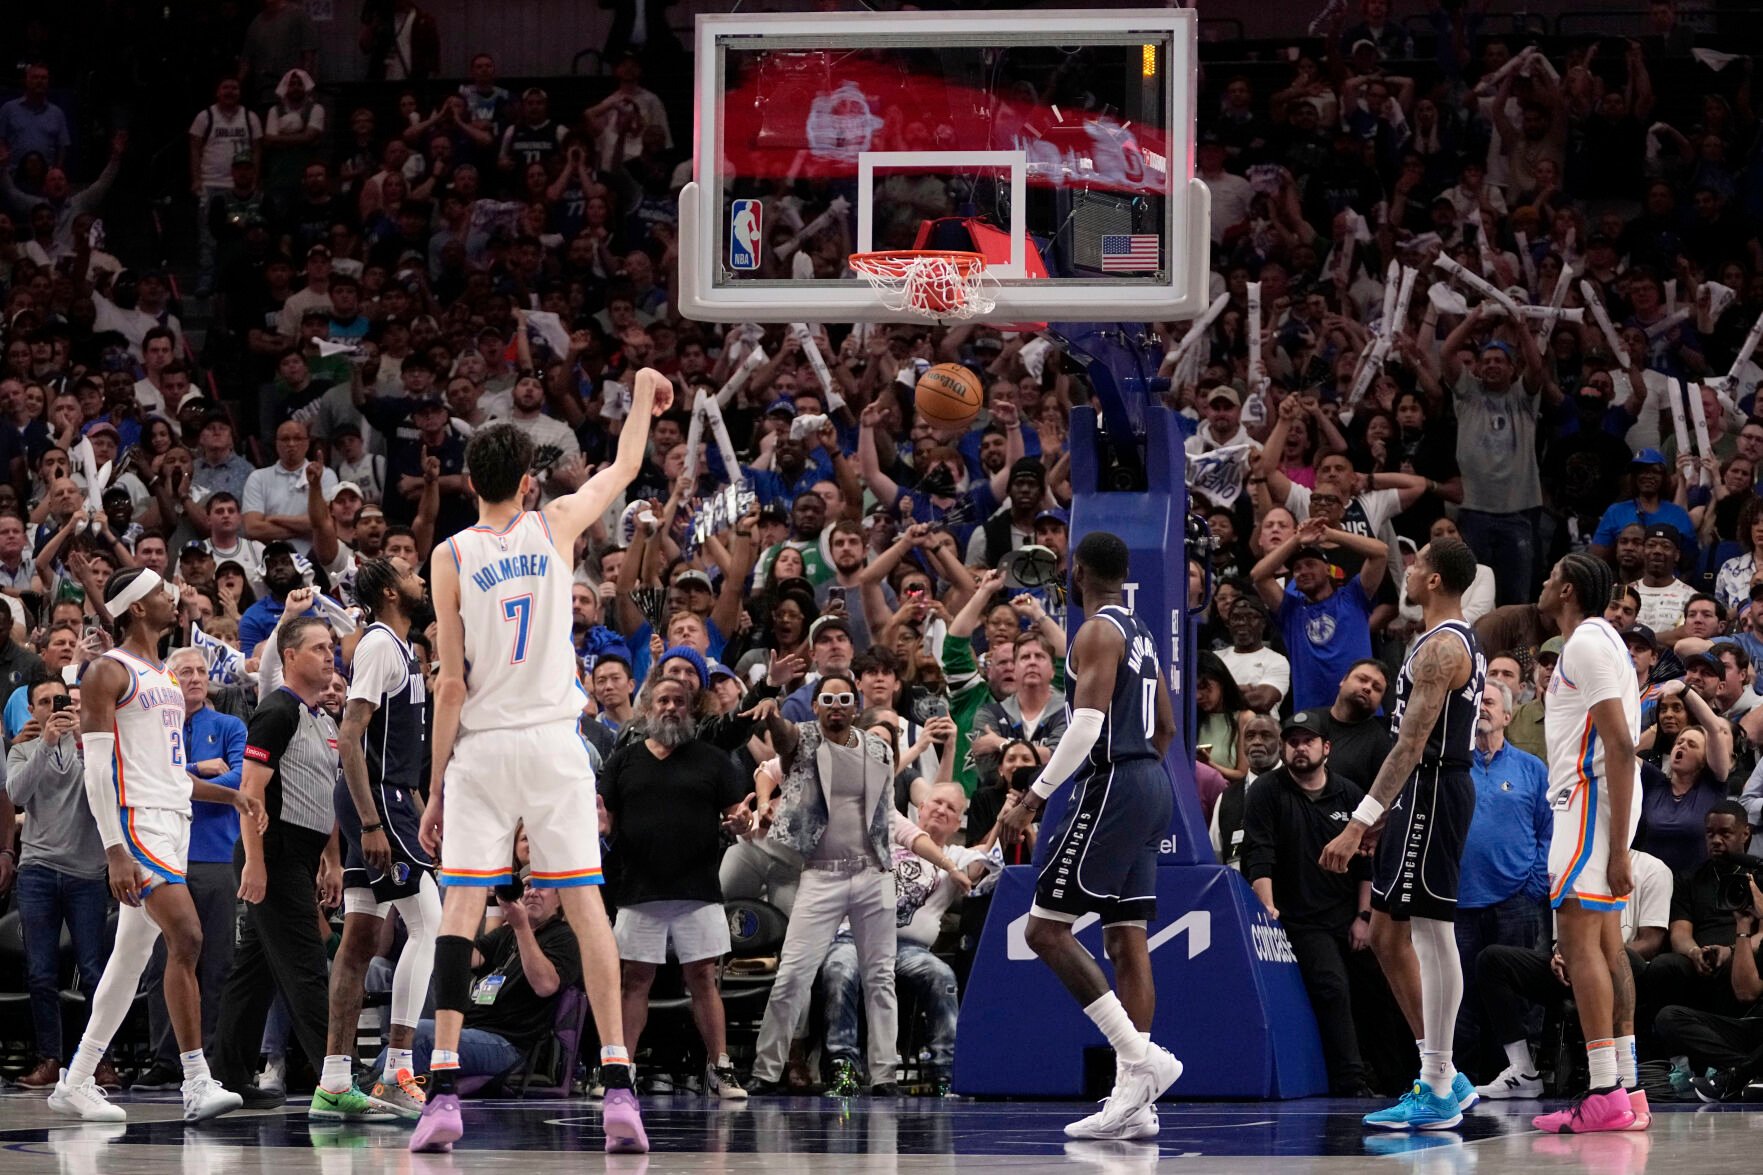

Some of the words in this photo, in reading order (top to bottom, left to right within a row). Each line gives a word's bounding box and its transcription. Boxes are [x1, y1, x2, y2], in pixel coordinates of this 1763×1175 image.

[734, 254, 749, 265] NBA
[472, 554, 548, 592] HOLMGREN
[501, 592, 533, 664] 7
[170, 730, 182, 767] 2
[246, 748, 266, 759] Emirates
[1052, 812, 1091, 898] MAVERICKS
[1401, 813, 1426, 902] MAVERICKS
[1251, 912, 1298, 963] coinbase
